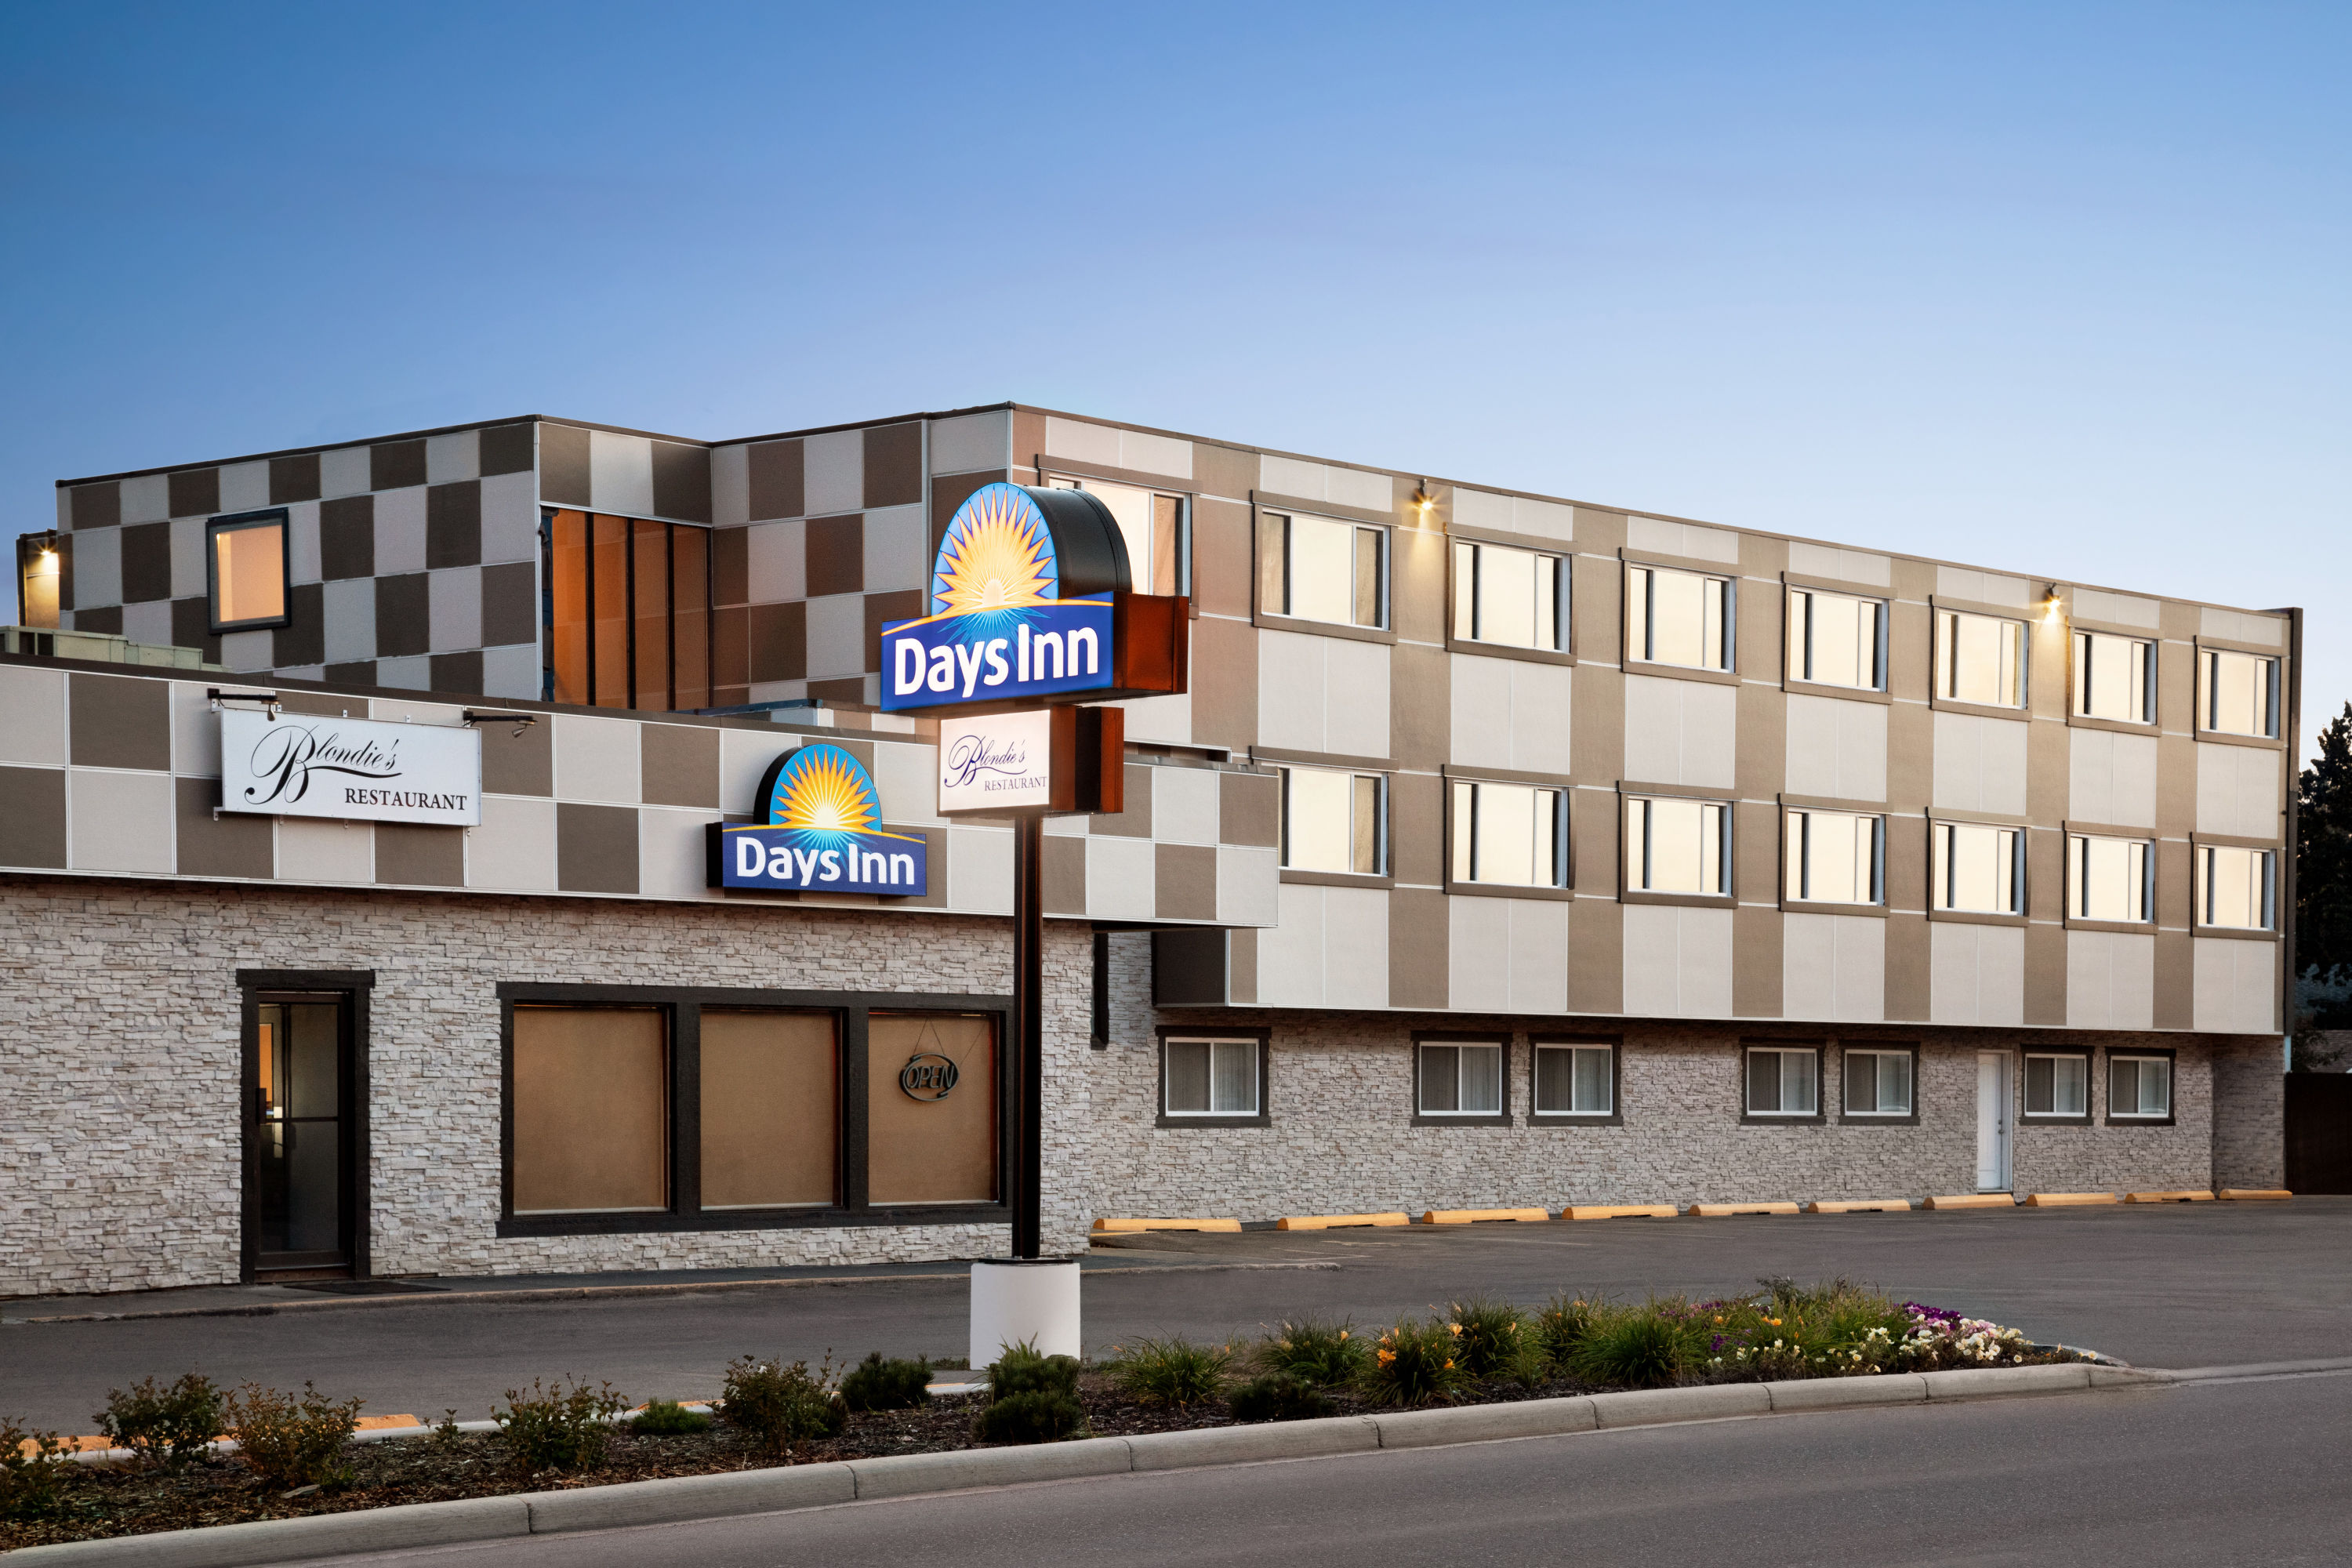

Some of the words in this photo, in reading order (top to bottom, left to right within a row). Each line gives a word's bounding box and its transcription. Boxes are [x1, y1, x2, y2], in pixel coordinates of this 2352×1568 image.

[895, 637, 1009, 698] Days
[1018, 623, 1098, 682] Inn
[244, 724, 402, 805] Blondie's
[944, 735, 1028, 788] Blondie's
[984, 776, 1048, 792] RESTAURANT
[344, 787, 467, 811] RESTAURANT
[736, 836, 841, 887] Days
[848, 843, 915, 885] Inn
[906, 1065, 954, 1089] OPEN
